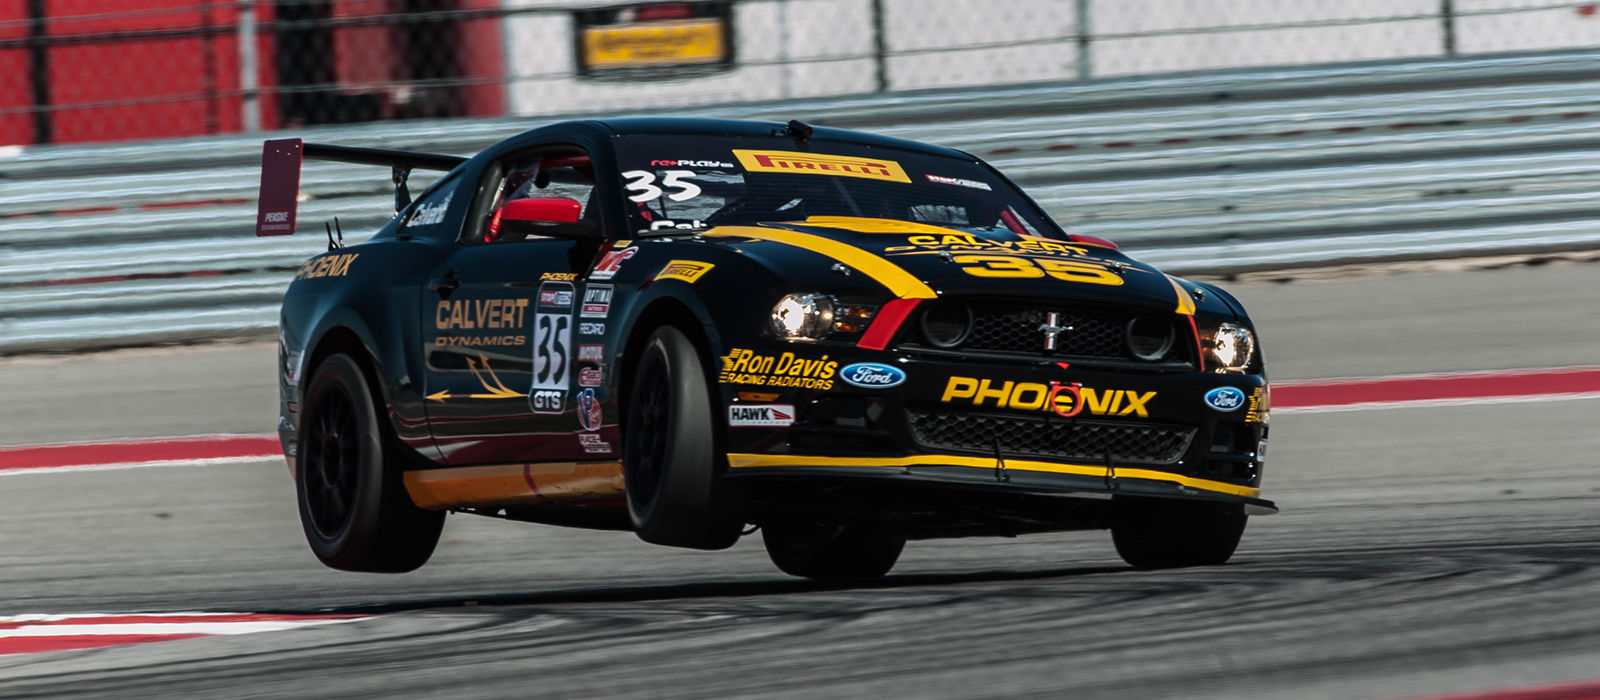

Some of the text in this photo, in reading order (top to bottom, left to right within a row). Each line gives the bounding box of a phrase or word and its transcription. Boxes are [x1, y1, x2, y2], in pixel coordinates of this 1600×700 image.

[752, 154, 890, 176] PIRELLI
[621, 170, 701, 201] 35
[908, 235, 1088, 256] CALVERT
[540, 272, 578, 281] PHOENIX
[953, 254, 1124, 286] 35
[436, 298, 528, 330] CALVERT
[579, 322, 605, 335] RECARO
[435, 335, 526, 347] DYNAMICS
[537, 315, 568, 385] 35
[731, 349, 838, 379] Ron Davis
[727, 373, 834, 390] RACING RADIATORS
[851, 366, 892, 384] Ford
[534, 391, 561, 409] GTS
[941, 376, 1157, 417] PHOENIX
[1213, 389, 1238, 407] Ford
[731, 407, 770, 421] HAWK
